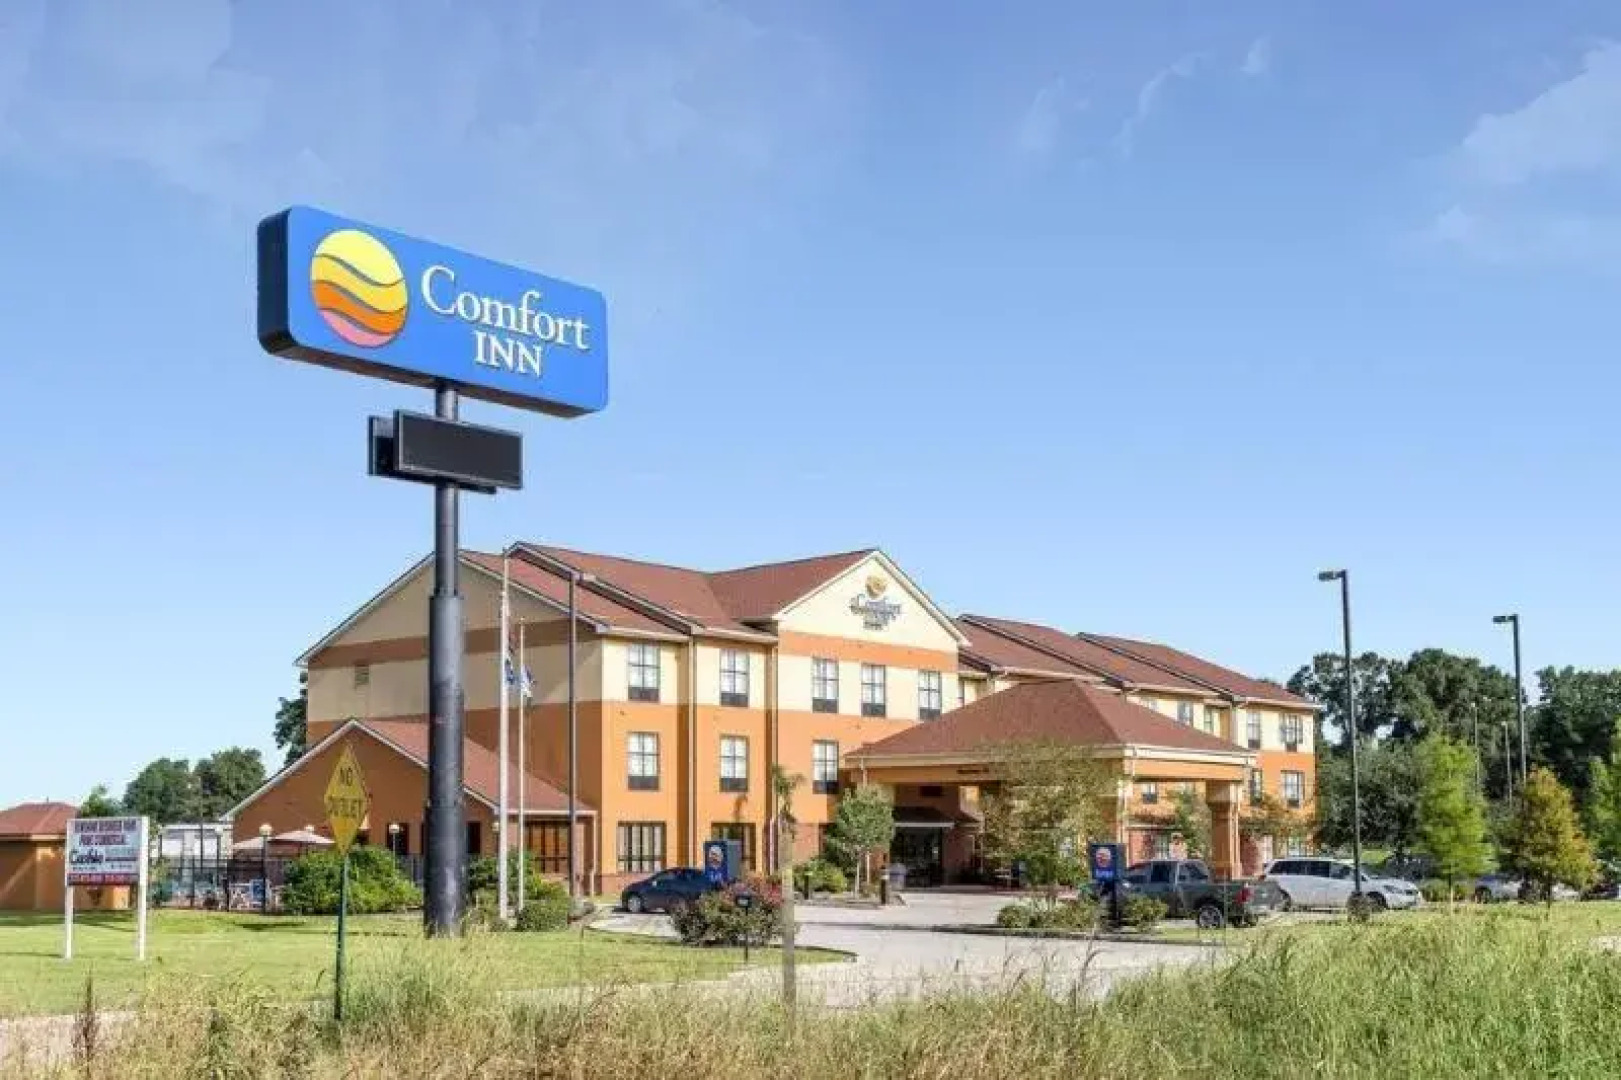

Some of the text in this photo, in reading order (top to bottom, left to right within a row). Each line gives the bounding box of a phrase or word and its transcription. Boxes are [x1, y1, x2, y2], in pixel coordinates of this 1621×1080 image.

[421, 264, 591, 350] Comfort
[473, 329, 544, 378] INN
[340, 767, 353, 787] NO
